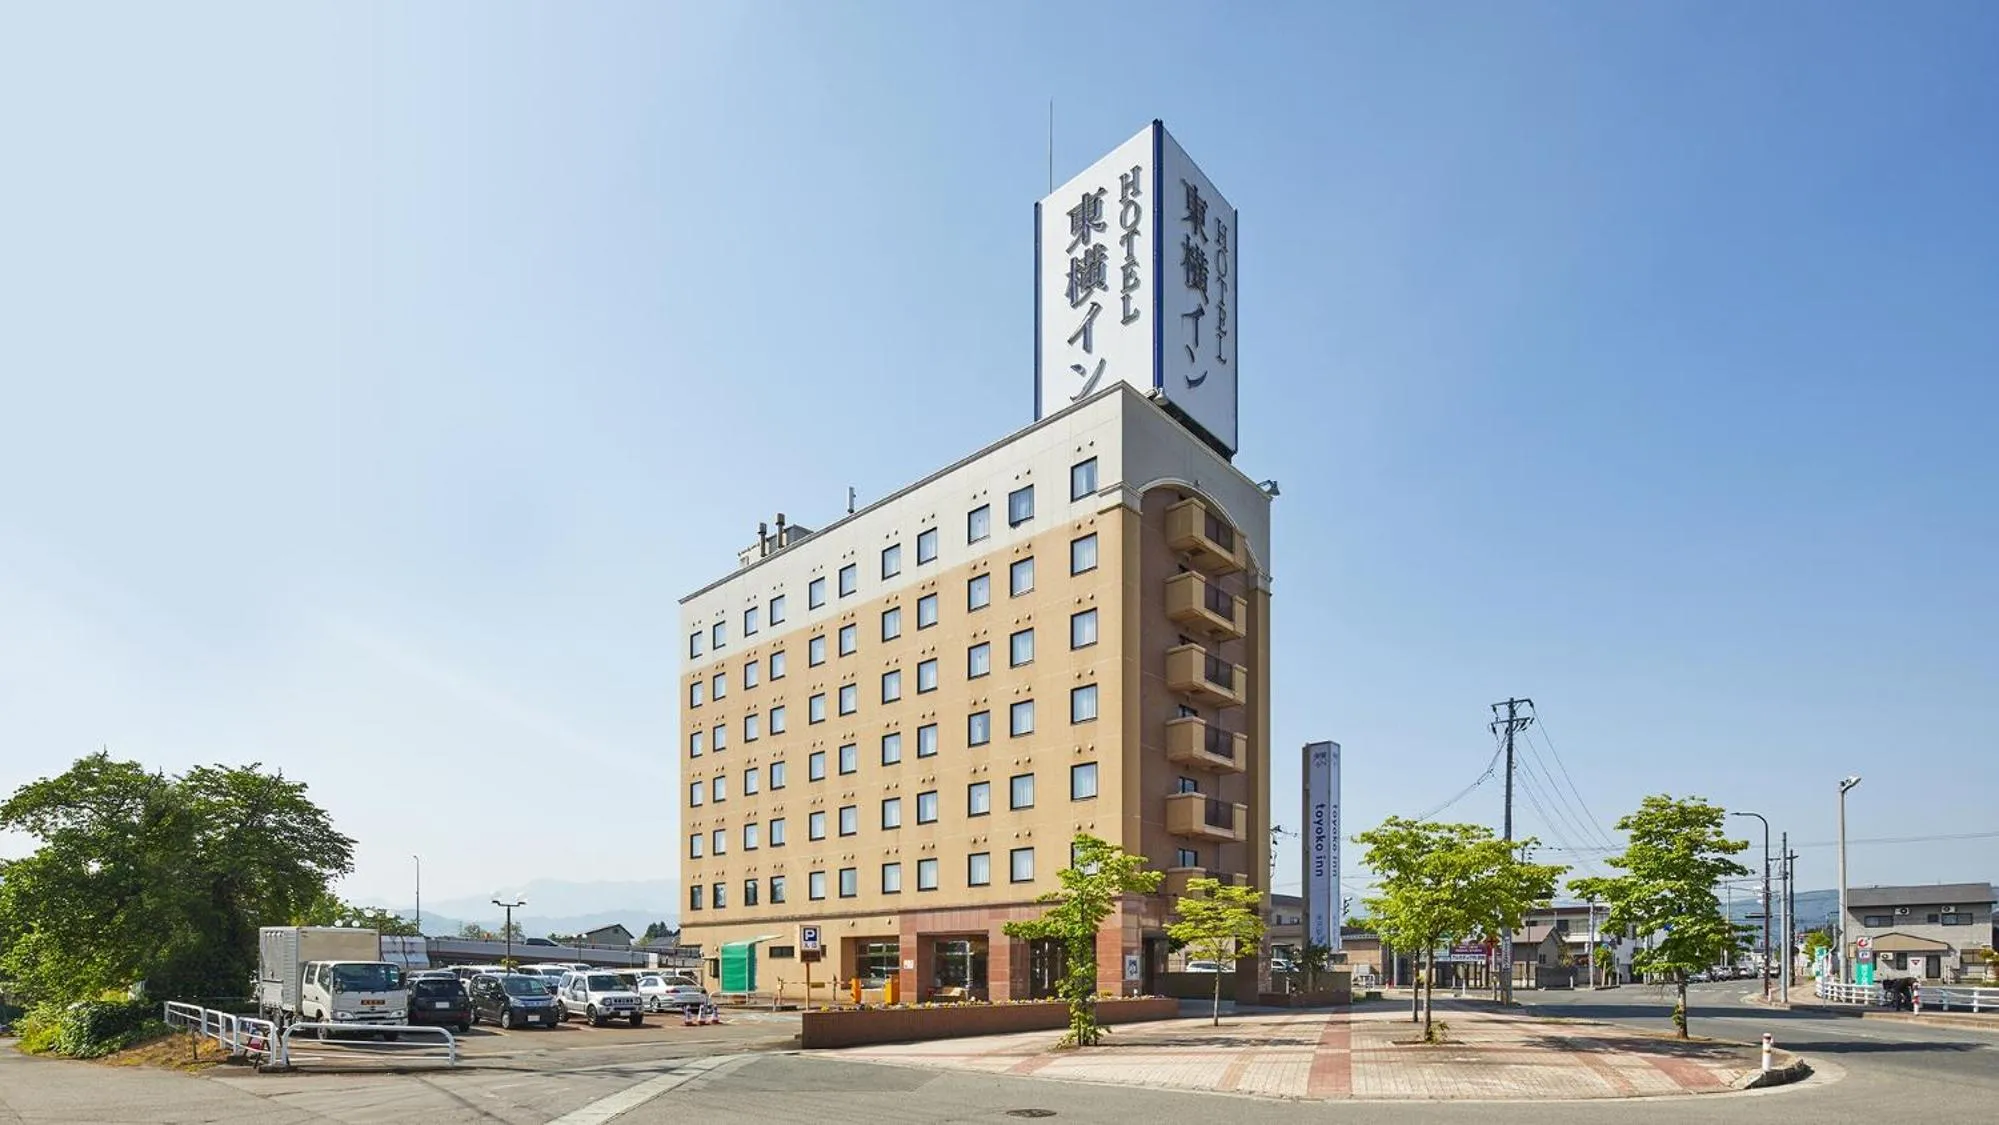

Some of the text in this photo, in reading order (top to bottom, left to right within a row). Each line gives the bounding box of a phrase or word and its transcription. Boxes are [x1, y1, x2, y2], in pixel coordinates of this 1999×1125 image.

[1065, 186, 1109, 401] 東横イン
[1118, 164, 1142, 326] HOTEL
[1179, 178, 1210, 390] 東横イン
[1213, 216, 1229, 366] HOTEL
[1312, 803, 1326, 878] toyoko inn
[804, 929, 815, 940] P
